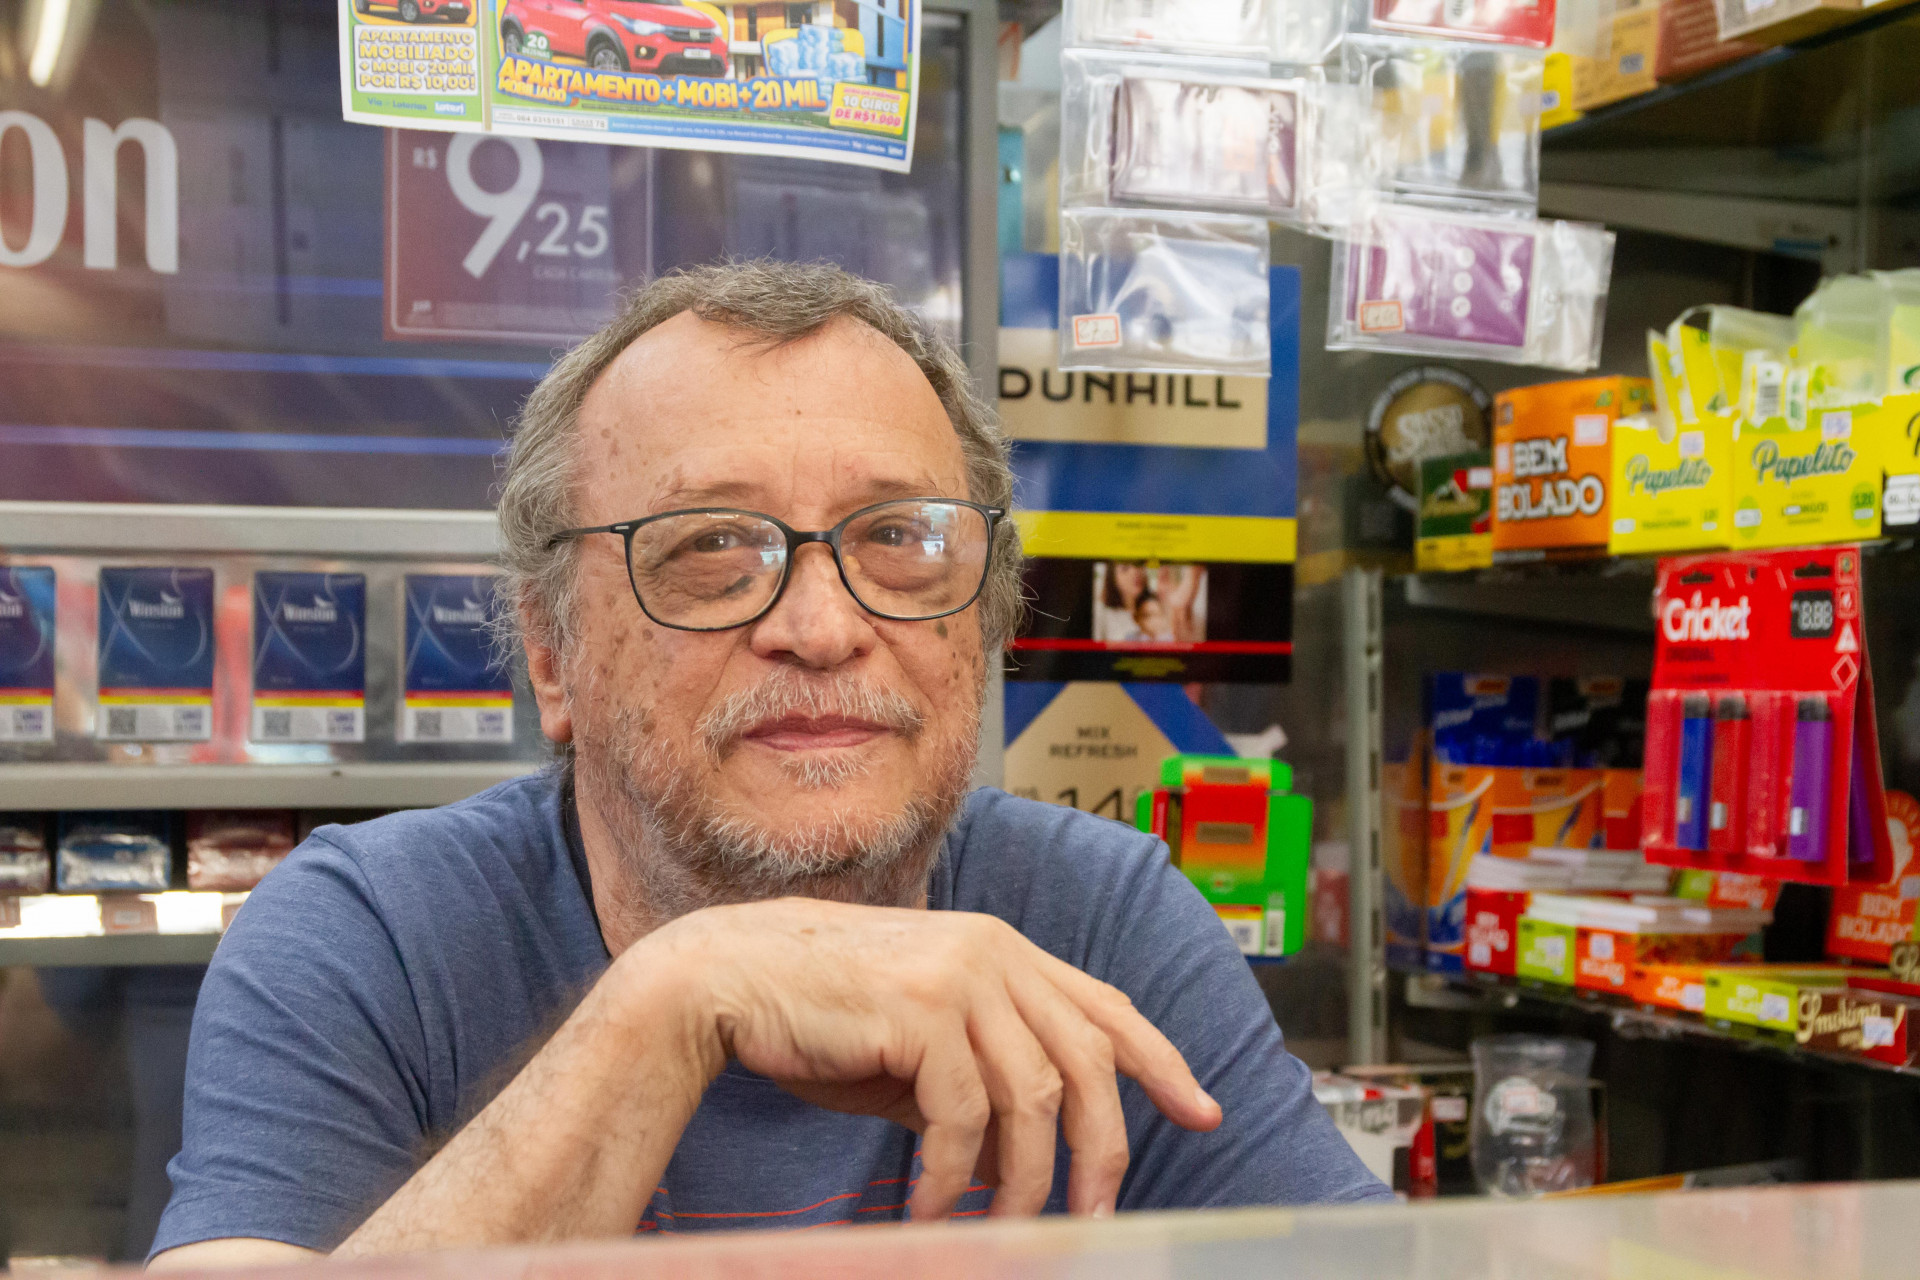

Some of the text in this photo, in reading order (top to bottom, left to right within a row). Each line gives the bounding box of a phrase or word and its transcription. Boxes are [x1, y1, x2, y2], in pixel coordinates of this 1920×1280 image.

[359, 31, 474, 44] APARTAMENTO
[527, 34, 548, 49] 20
[359, 44, 475, 60] MOBILIADO
[372, 61, 415, 73] MOBI
[360, 74, 475, 91] POR R$ 10,00!
[843, 95, 899, 113] 10 GIROS
[835, 108, 852, 119] DE
[998, 367, 1243, 409] DUNHILL
[1513, 437, 1569, 479] BEM
[1752, 439, 1857, 488] Papelito
[1626, 454, 1713, 498] Papelito
[1497, 475, 1605, 523] BOLADO
[1662, 589, 1751, 642] Cricket
[1049, 744, 1138, 758] REFRESH
